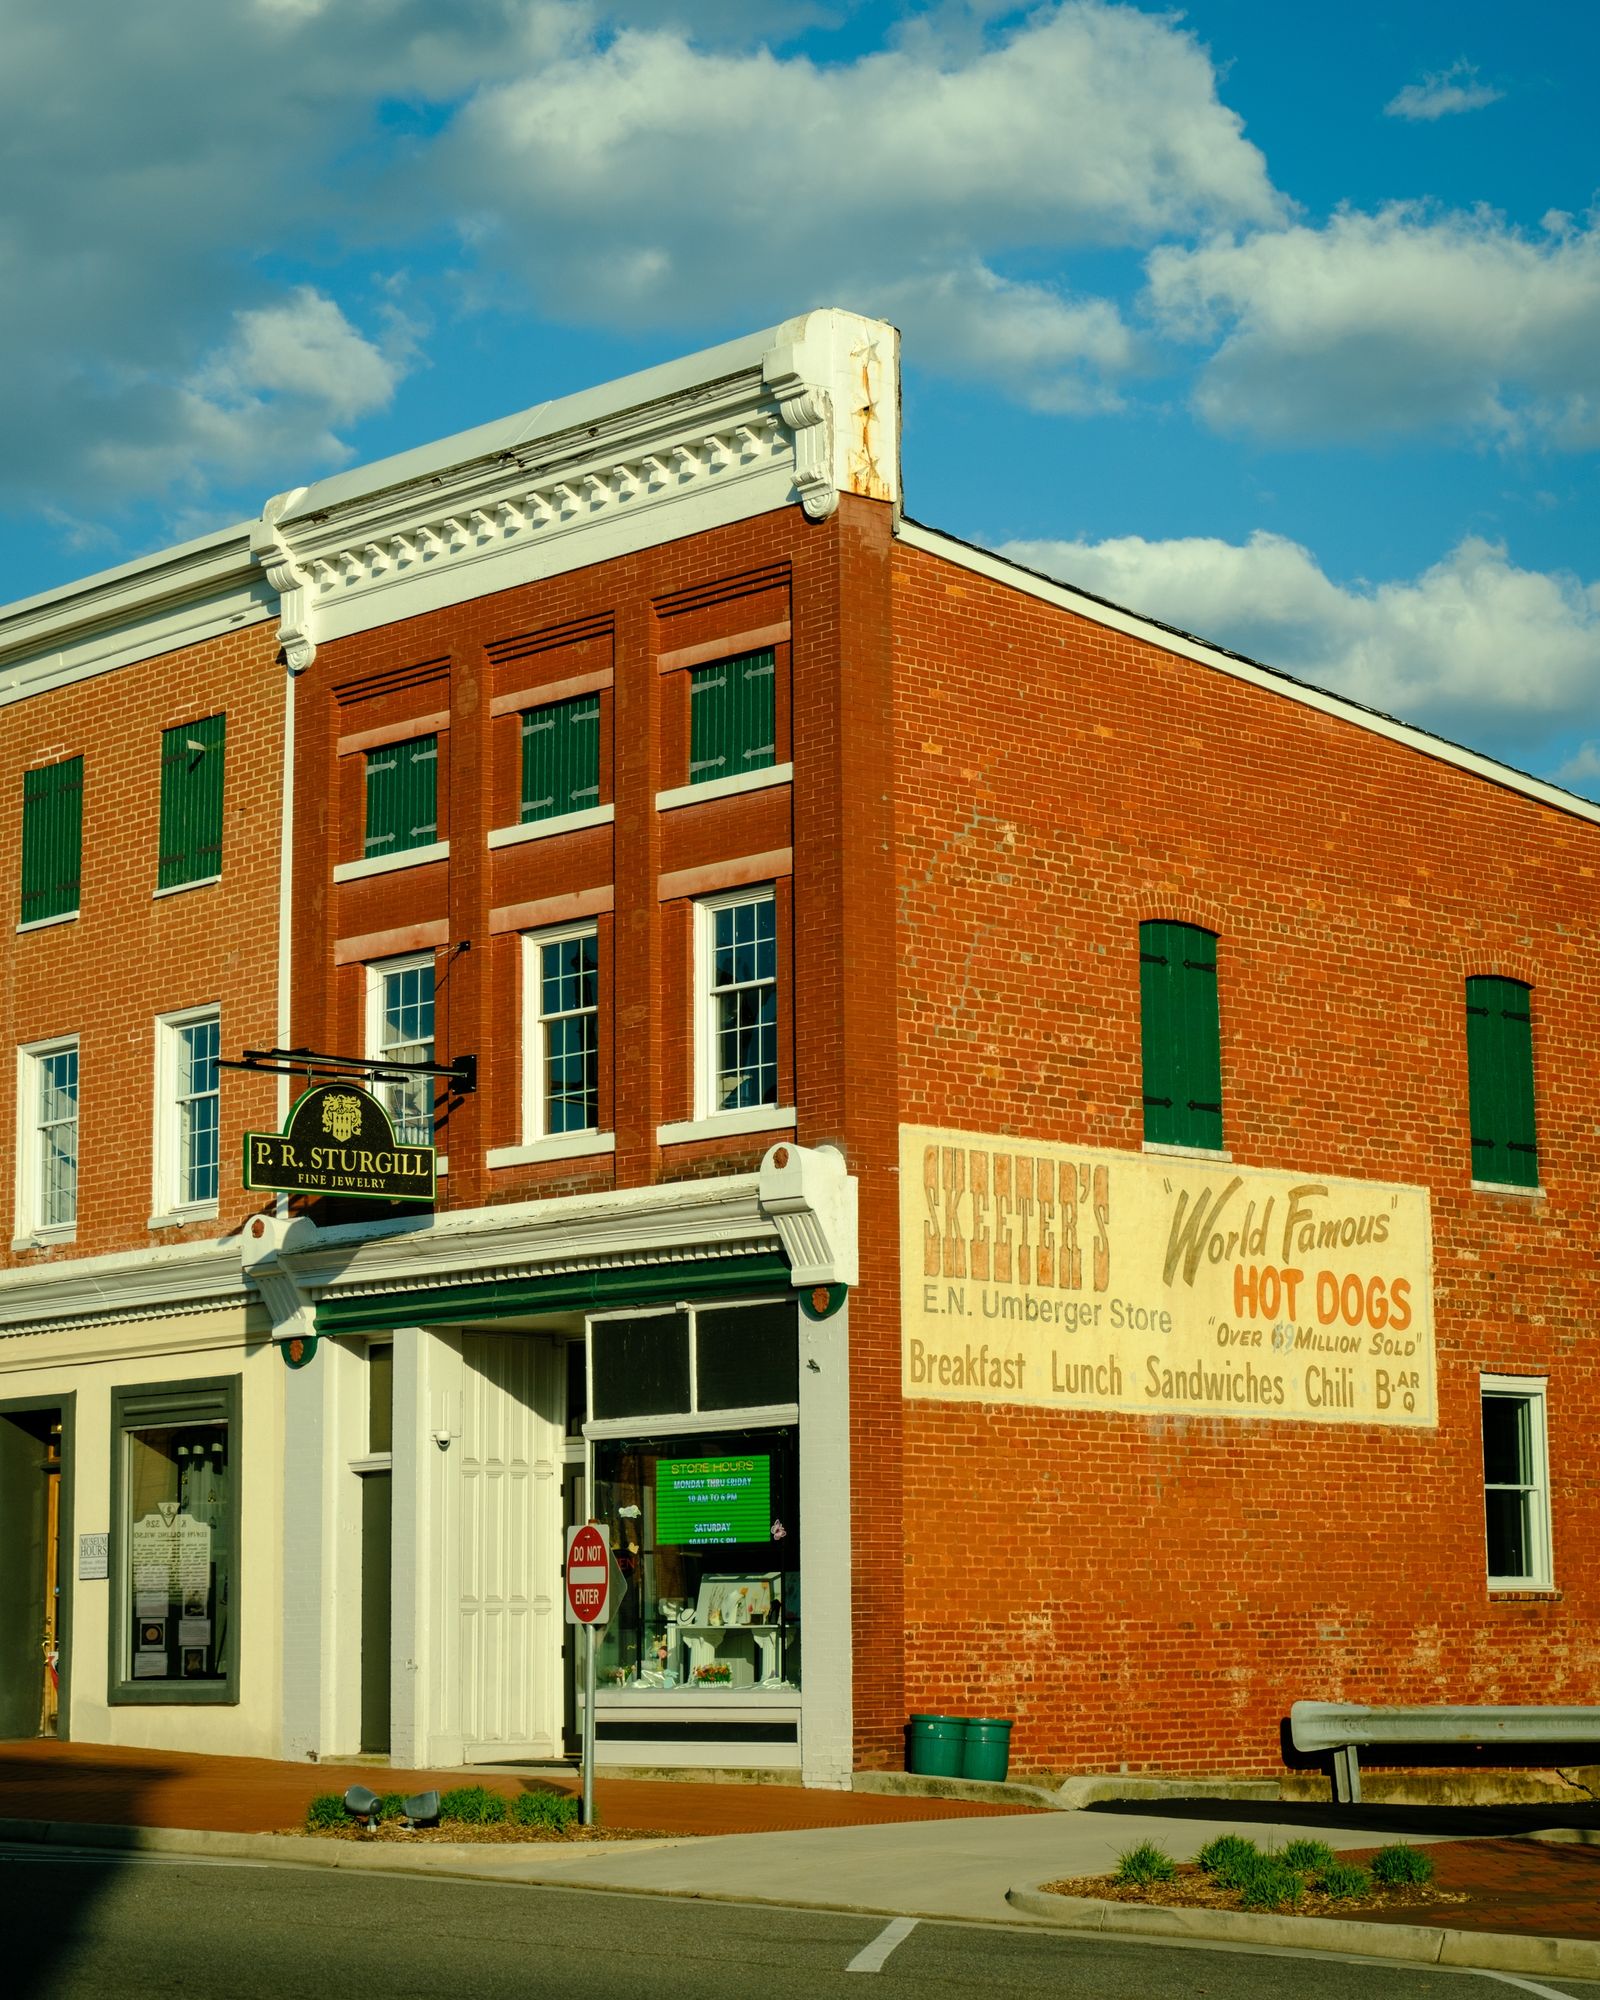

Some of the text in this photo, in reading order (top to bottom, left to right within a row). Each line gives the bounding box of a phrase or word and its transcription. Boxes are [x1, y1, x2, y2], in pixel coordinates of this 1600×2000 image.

[256, 1142, 429, 1177] P. R. STURGILL
[298, 1173, 386, 1189] FINE JEWELRY
[923, 1144, 1110, 1293] SKEETER'S
[1234, 1264, 1412, 1331] HOT DOGS
[923, 1284, 1173, 1334] E.N. Umberger Store
[910, 1338, 1027, 1390] Breakfast
[1052, 1349, 1123, 1396] Lunch
[1144, 1354, 1285, 1406] Sandwiches
[1305, 1365, 1355, 1408] Chili
[671, 1460, 753, 1475] STORE HOURS
[673, 1477, 752, 1489] MONDAY THRU FRIDAY
[697, 1494, 709, 1503] AM
[710, 1493, 719, 1502] TO
[727, 1492, 738, 1501] PM
[694, 1522, 731, 1533] SATURDAY
[574, 1545, 602, 1562] DO NOT
[575, 1588, 600, 1605] ENTER
